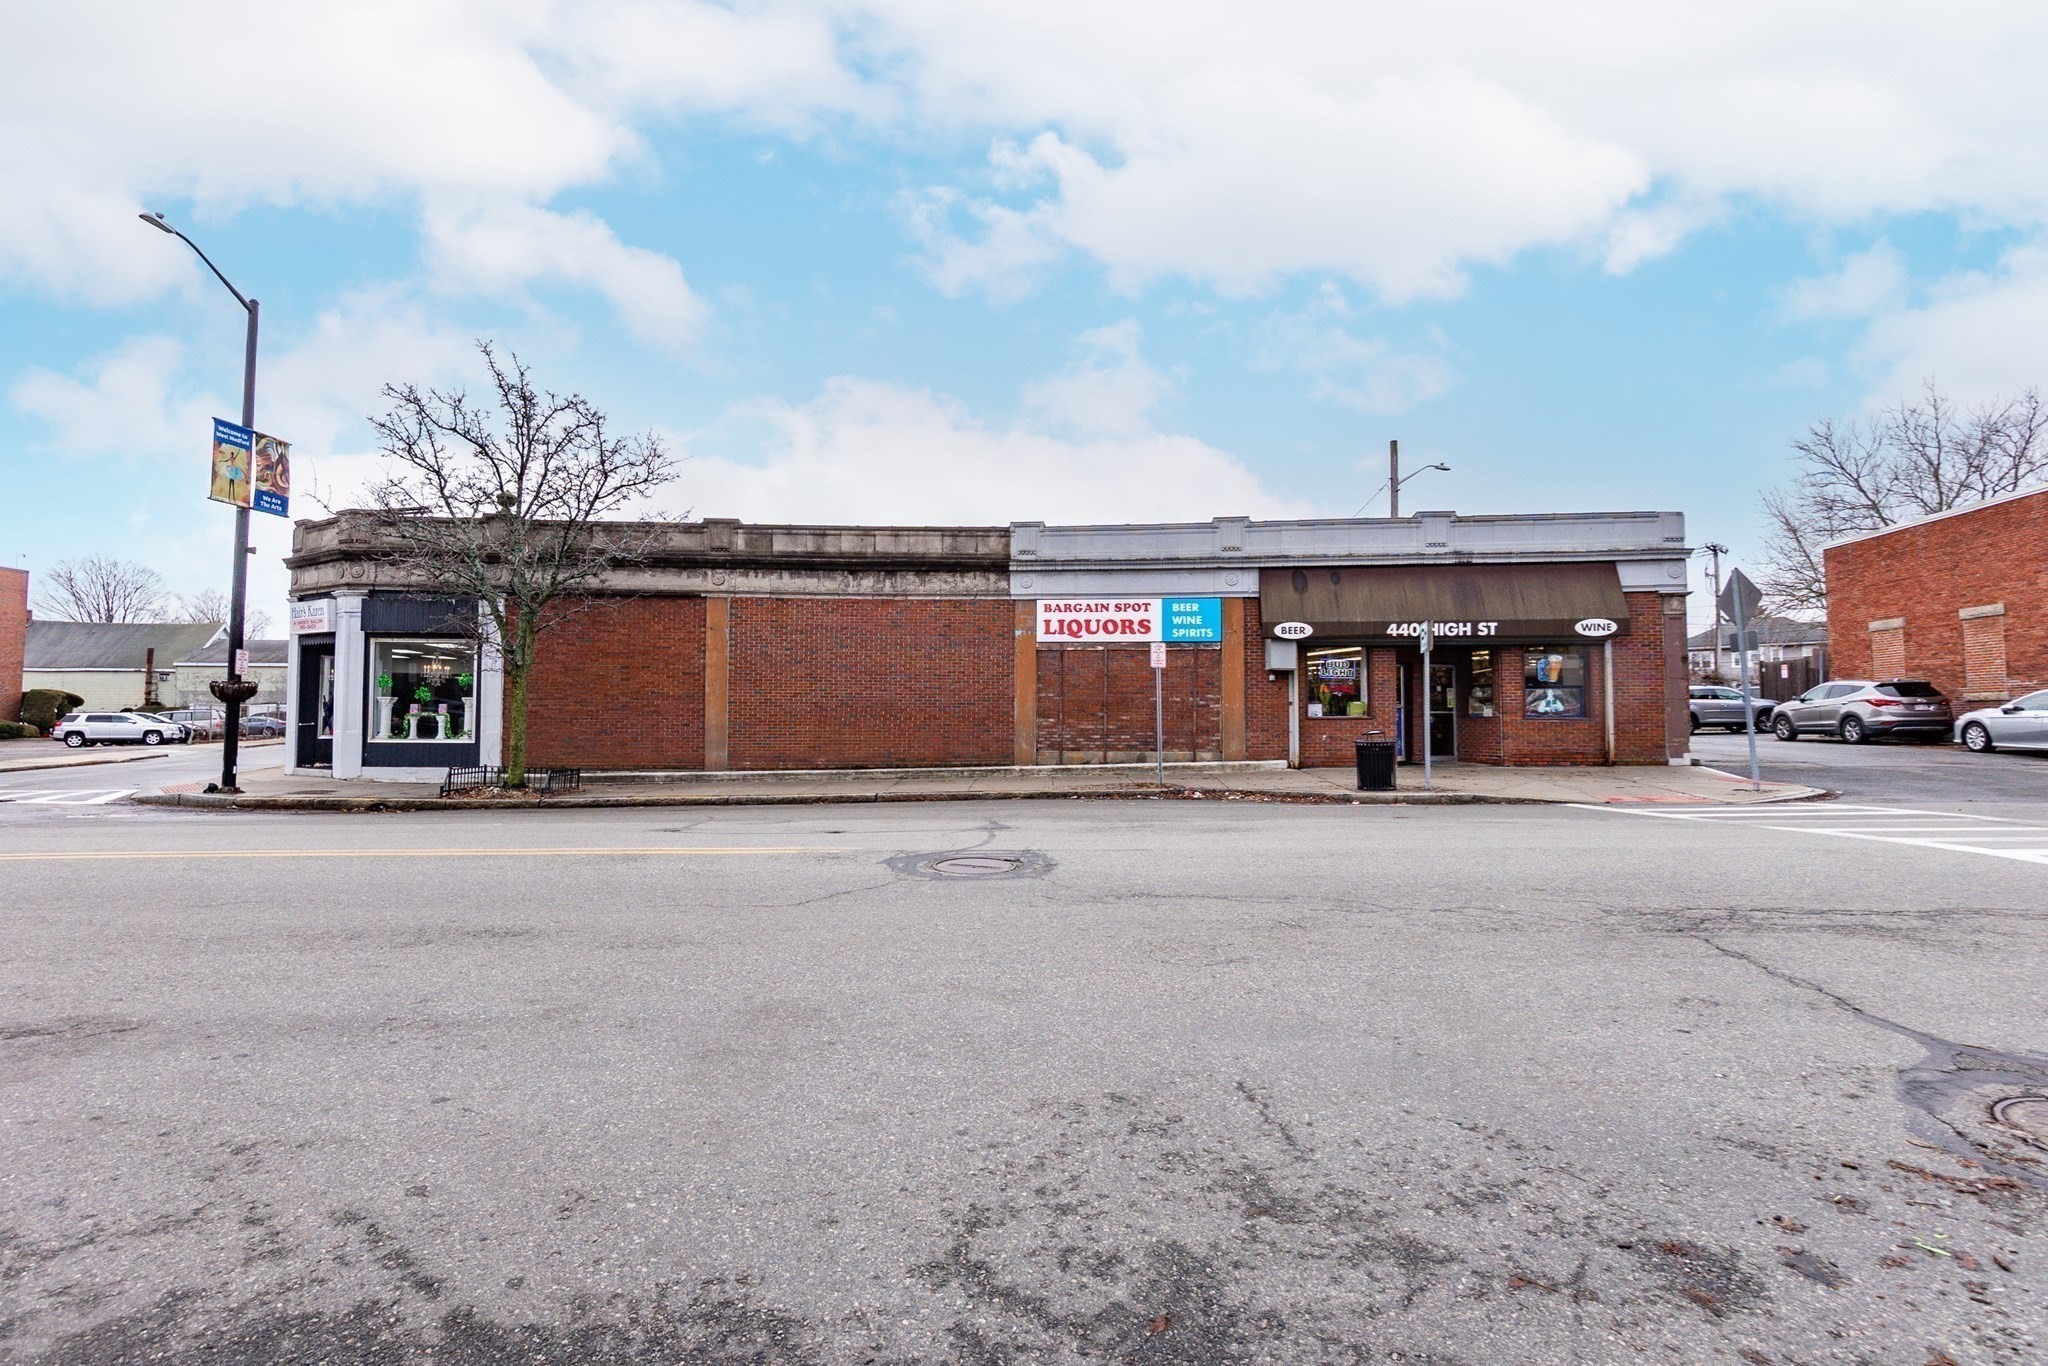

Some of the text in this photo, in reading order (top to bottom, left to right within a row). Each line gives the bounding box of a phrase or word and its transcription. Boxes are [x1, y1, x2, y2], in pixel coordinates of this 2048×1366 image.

[218, 424, 241, 437] Welcome
[216, 430, 250, 446] West Medford
[262, 495, 271, 503] We
[1043, 602, 1151, 613] BARGAIN SPOT
[1172, 603, 1200, 612] BEER
[1172, 616, 1203, 625] WINE
[1043, 618, 1152, 638] LIQUORS
[1280, 626, 1306, 636] BEER
[1386, 623, 1420, 637] 440
[1477, 622, 1498, 636] ST
[1580, 622, 1613, 633] WINE
[1172, 628, 1213, 638] SPIRITS
[1325, 660, 1350, 668] BUD
[1320, 668, 1354, 677] LIGHT
